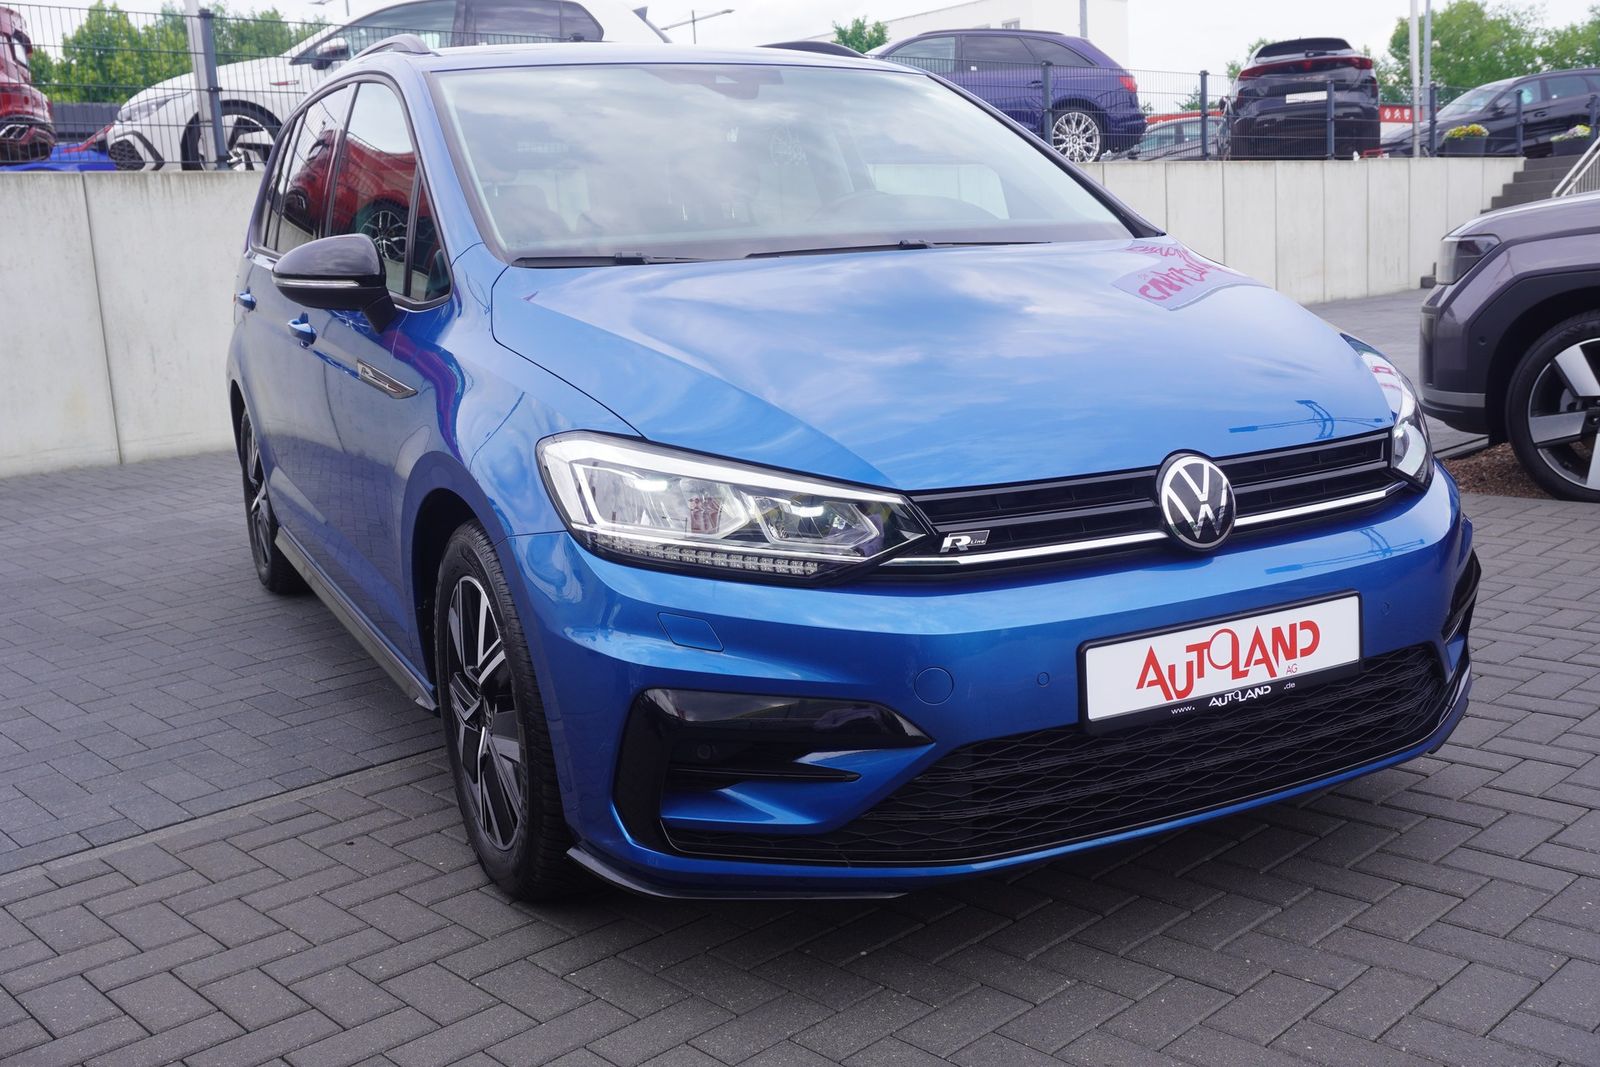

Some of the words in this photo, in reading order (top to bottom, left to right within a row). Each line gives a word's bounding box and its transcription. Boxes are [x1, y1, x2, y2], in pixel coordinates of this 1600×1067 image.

[1136, 620, 1320, 701] AUTOLAND
[1286, 663, 1298, 673] AG
[1209, 686, 1272, 706] AUTOLAND
